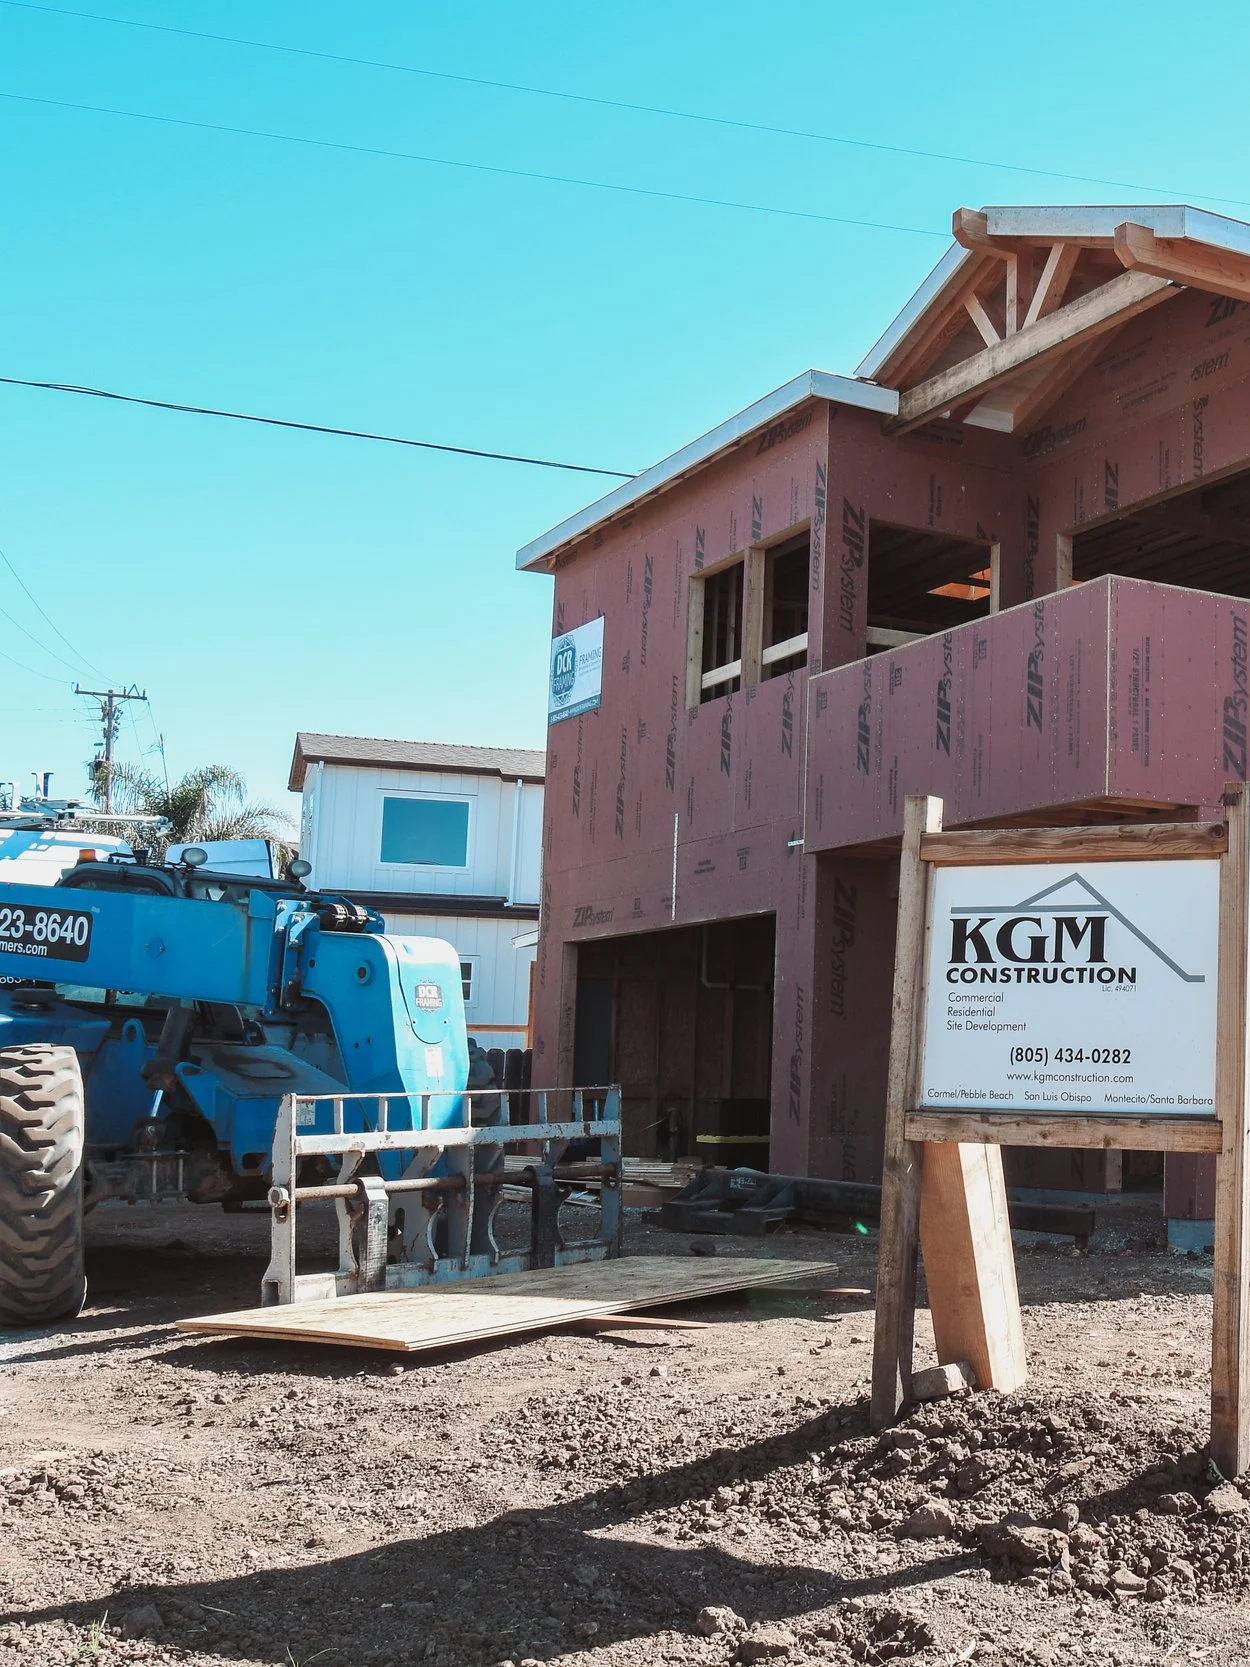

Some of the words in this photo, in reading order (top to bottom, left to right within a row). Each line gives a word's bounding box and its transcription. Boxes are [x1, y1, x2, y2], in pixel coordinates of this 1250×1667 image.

[840, 497, 864, 633] ZIPsystem
[557, 650, 573, 676] DCR
[1223, 614, 1247, 781] ZIPsystem
[0, 908, 89, 946] 23-8640
[948, 916, 1109, 963] KGM
[0, 941, 48, 956] mers.com
[946, 967, 1137, 984] CONSTRUCTION
[418, 985, 439, 998] DCR
[1115, 985, 1137, 993] 494071
[416, 998, 443, 1007] FRAMING
[948, 992, 1004, 1003] Commercial
[947, 1006, 996, 1017] Residential
[946, 1020, 963, 1031] Site
[965, 1020, 1026, 1033] Development
[1010, 1046, 1049, 1066] (805)
[1054, 1047, 1131, 1064] 434-0282
[1006, 1070, 1134, 1084] www.kgmconstruction.com
[927, 1088, 987, 1100] Carmel/Pebble
[989, 1089, 1014, 1100] Beach
[1024, 1091, 1040, 1101] San
[1042, 1092, 1058, 1101] Luis
[1060, 1092, 1092, 1104] Obispo
[1104, 1093, 1175, 1105] Montecito/Santa
[1177, 1095, 1213, 1105] Barbara
